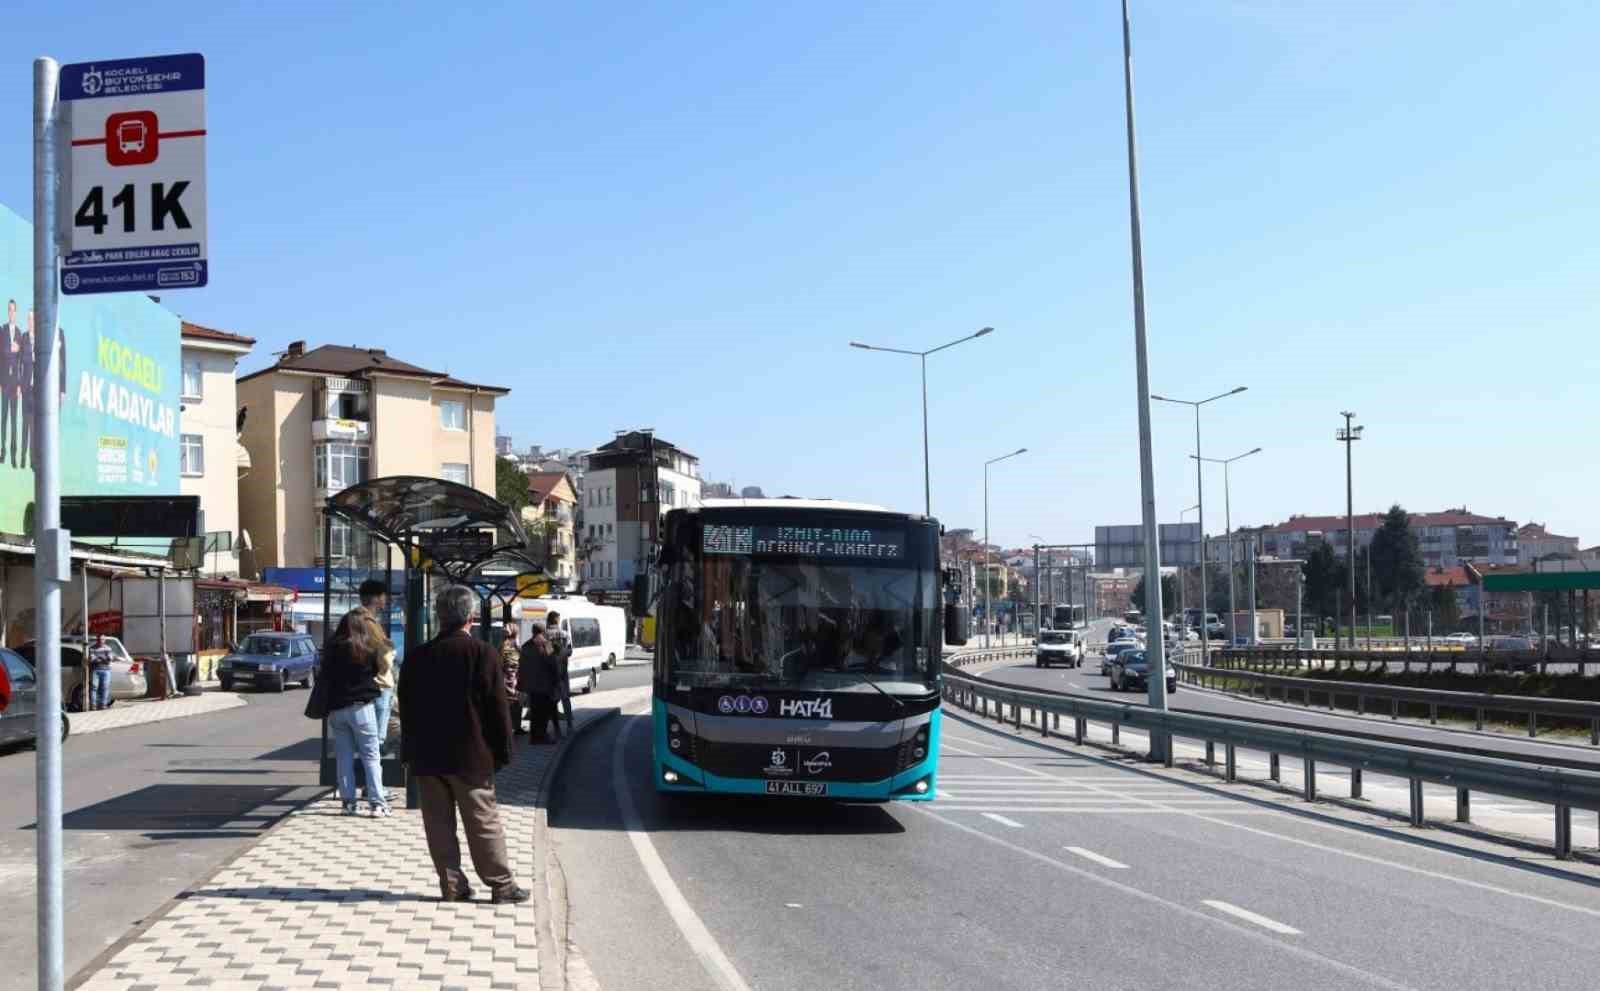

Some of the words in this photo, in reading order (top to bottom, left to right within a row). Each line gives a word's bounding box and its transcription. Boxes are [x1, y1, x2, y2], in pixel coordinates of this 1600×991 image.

[75, 183, 135, 235] 41
[151, 180, 193, 231] K
[79, 370, 105, 413] AK
[107, 383, 175, 439] ADAYLAR
[767, 781, 780, 792] 41
[782, 781, 801, 793] ALL
